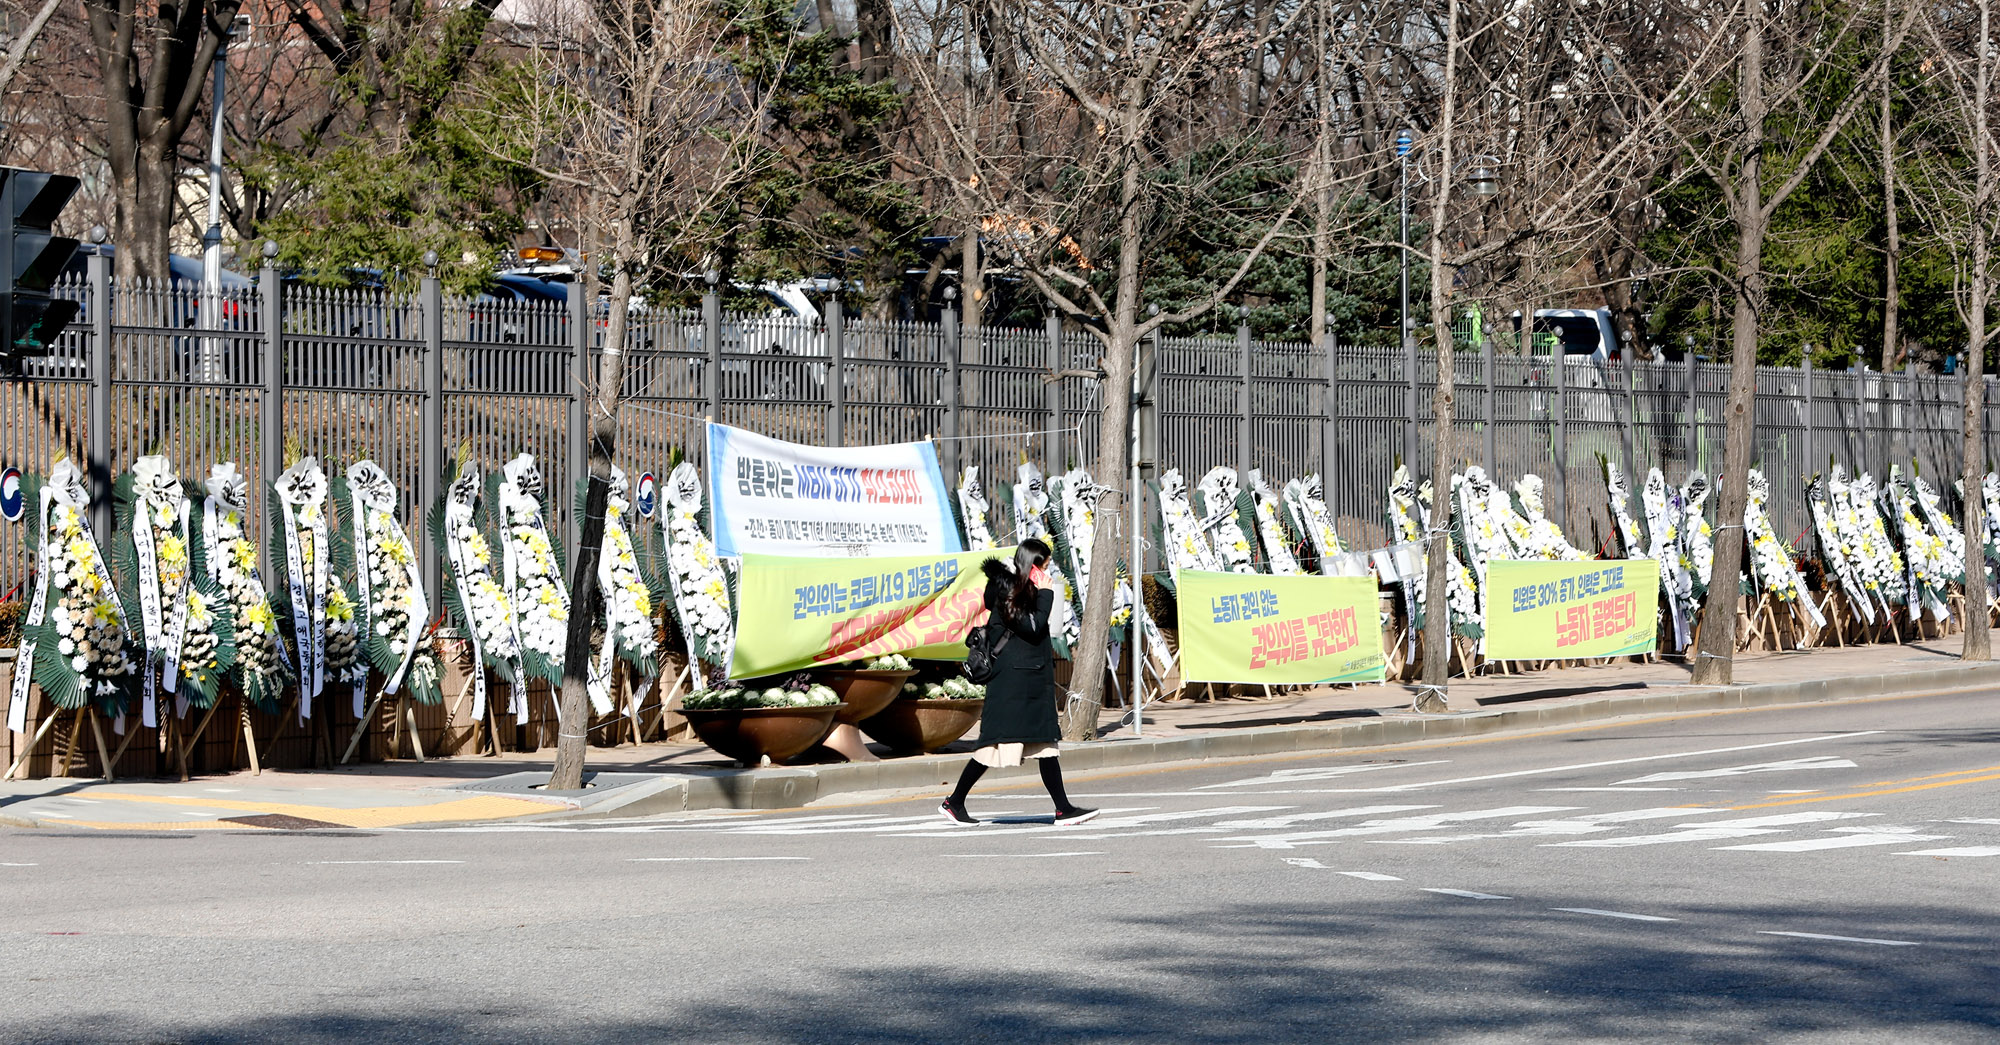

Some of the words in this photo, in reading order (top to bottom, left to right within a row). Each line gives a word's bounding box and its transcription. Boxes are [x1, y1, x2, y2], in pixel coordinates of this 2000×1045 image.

[737, 456, 794, 499] 방통위는
[794, 465, 832, 500] MBN
[830, 466, 861, 503] 허가
[860, 467, 922, 504] 취소하라!
[802, 520, 824, 541] 무기한
[864, 523, 879, 542] 노숙
[879, 523, 896, 543] 농성
[794, 582, 847, 620] 권익위는
[850, 572, 904, 610] 코로나19
[907, 565, 931, 598] 과중
[933, 558, 958, 593] 업무
[1211, 593, 1240, 624] 노동자
[1240, 590, 1260, 621] 권익
[1260, 589, 1279, 617] 없는
[1513, 584, 1536, 613] 민원은
[1538, 581, 1558, 607] 30%
[1559, 576, 1576, 604] 증가,
[1578, 571, 1600, 599] 인력은
[1601, 566, 1624, 593] 그대로,
[913, 587, 989, 645] 보상하
[1249, 618, 1308, 670] 권익위를
[1307, 606, 1359, 658] 규탄한다
[1556, 603, 1590, 648] 노동자
[1592, 591, 1636, 640] 골병든다
